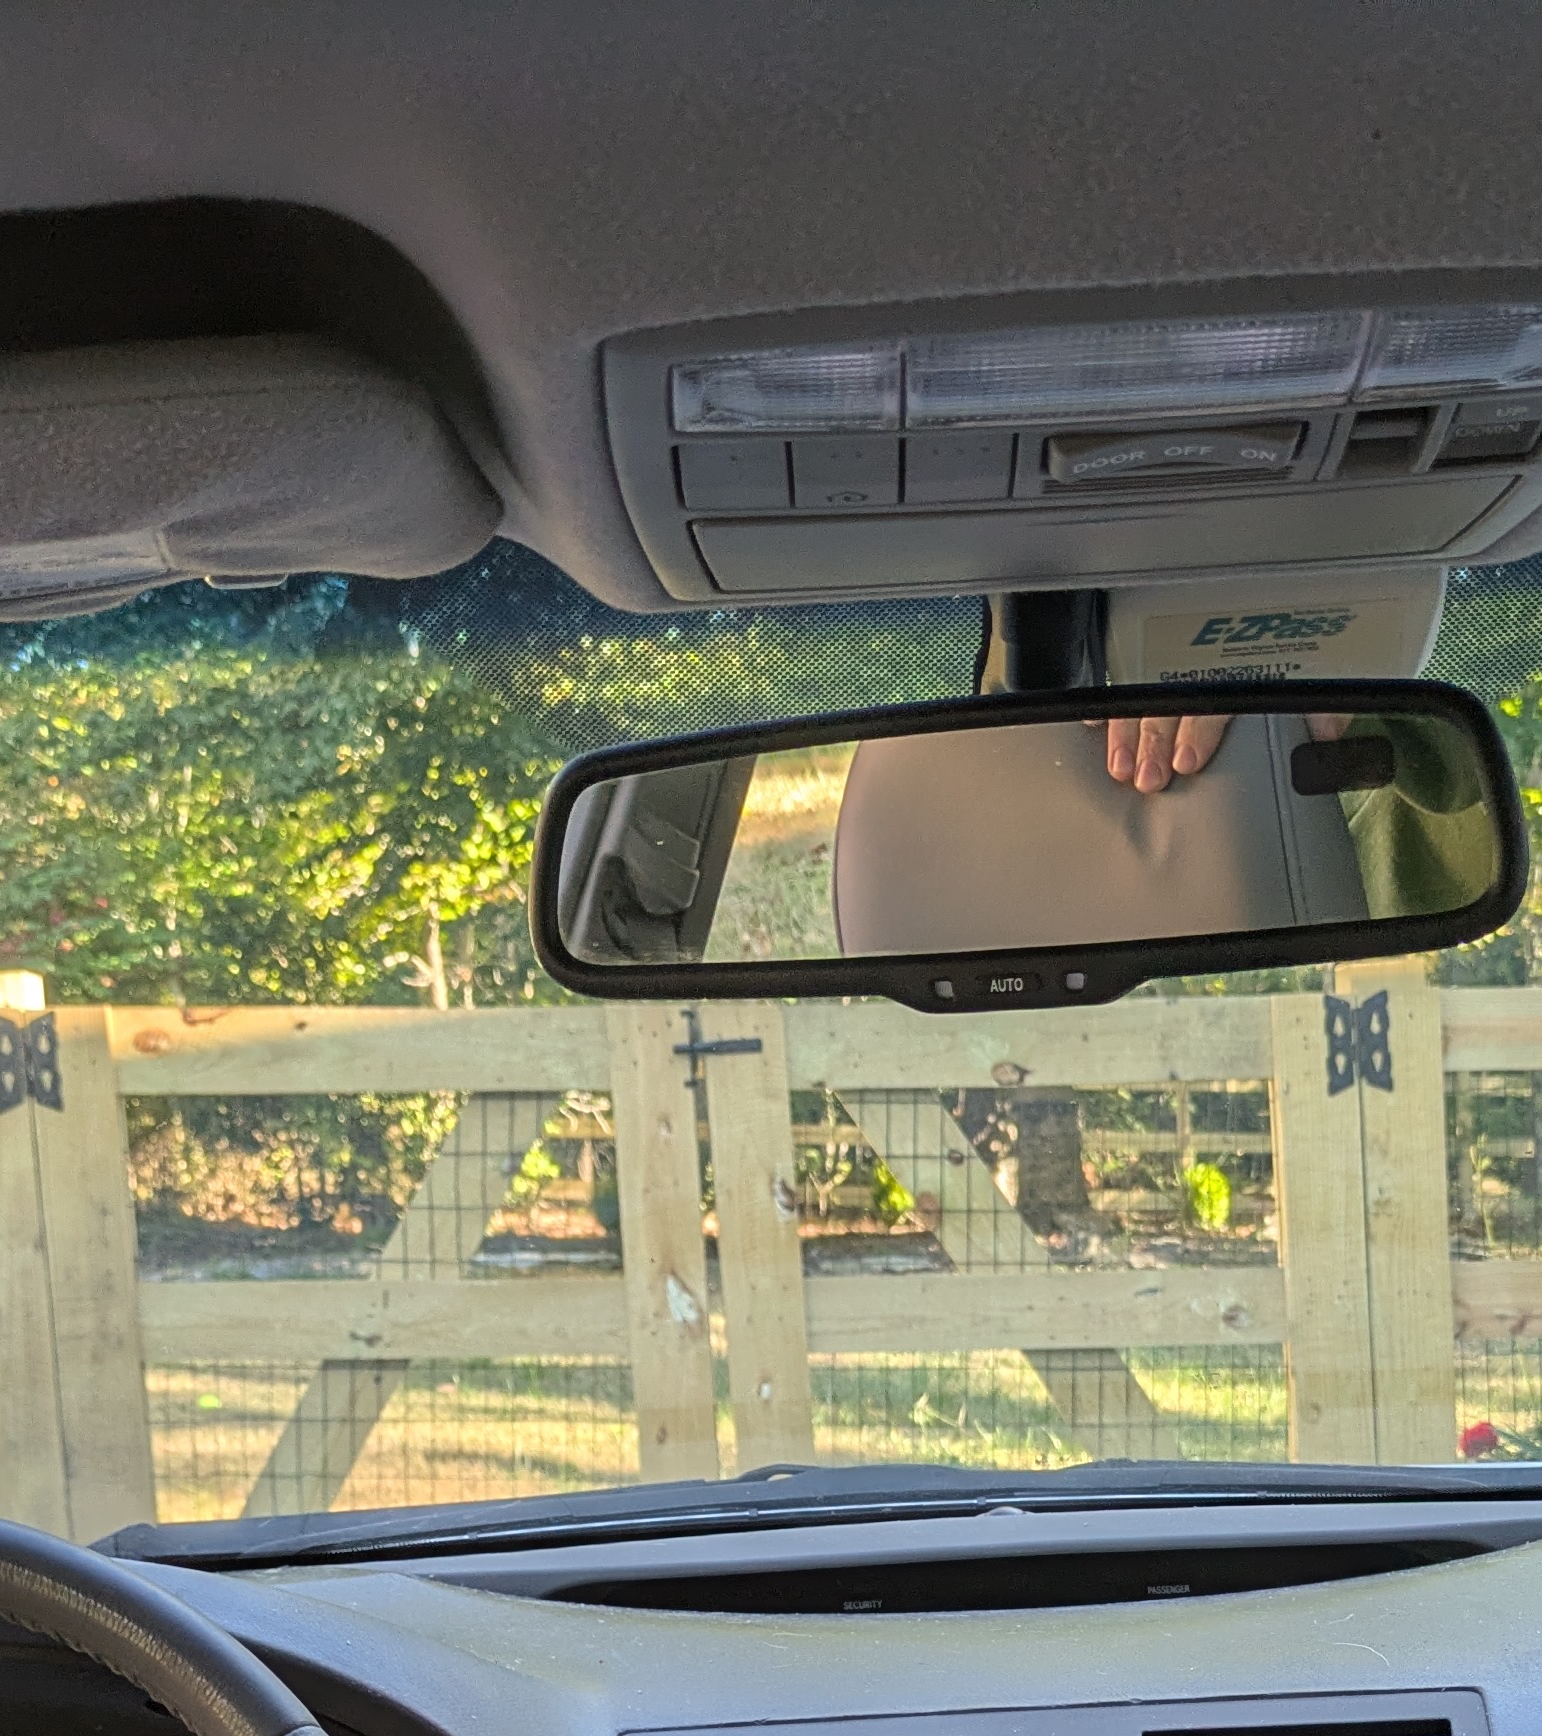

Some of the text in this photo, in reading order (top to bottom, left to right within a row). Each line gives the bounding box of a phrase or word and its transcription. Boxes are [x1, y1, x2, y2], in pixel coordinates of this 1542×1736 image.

[1073, 445, 1278, 474] DOOR OFF ON
[990, 977, 1024, 993] AUTO
[1146, 1584, 1190, 1596] PASSENGER
[843, 1599, 883, 1610] SECURITY
